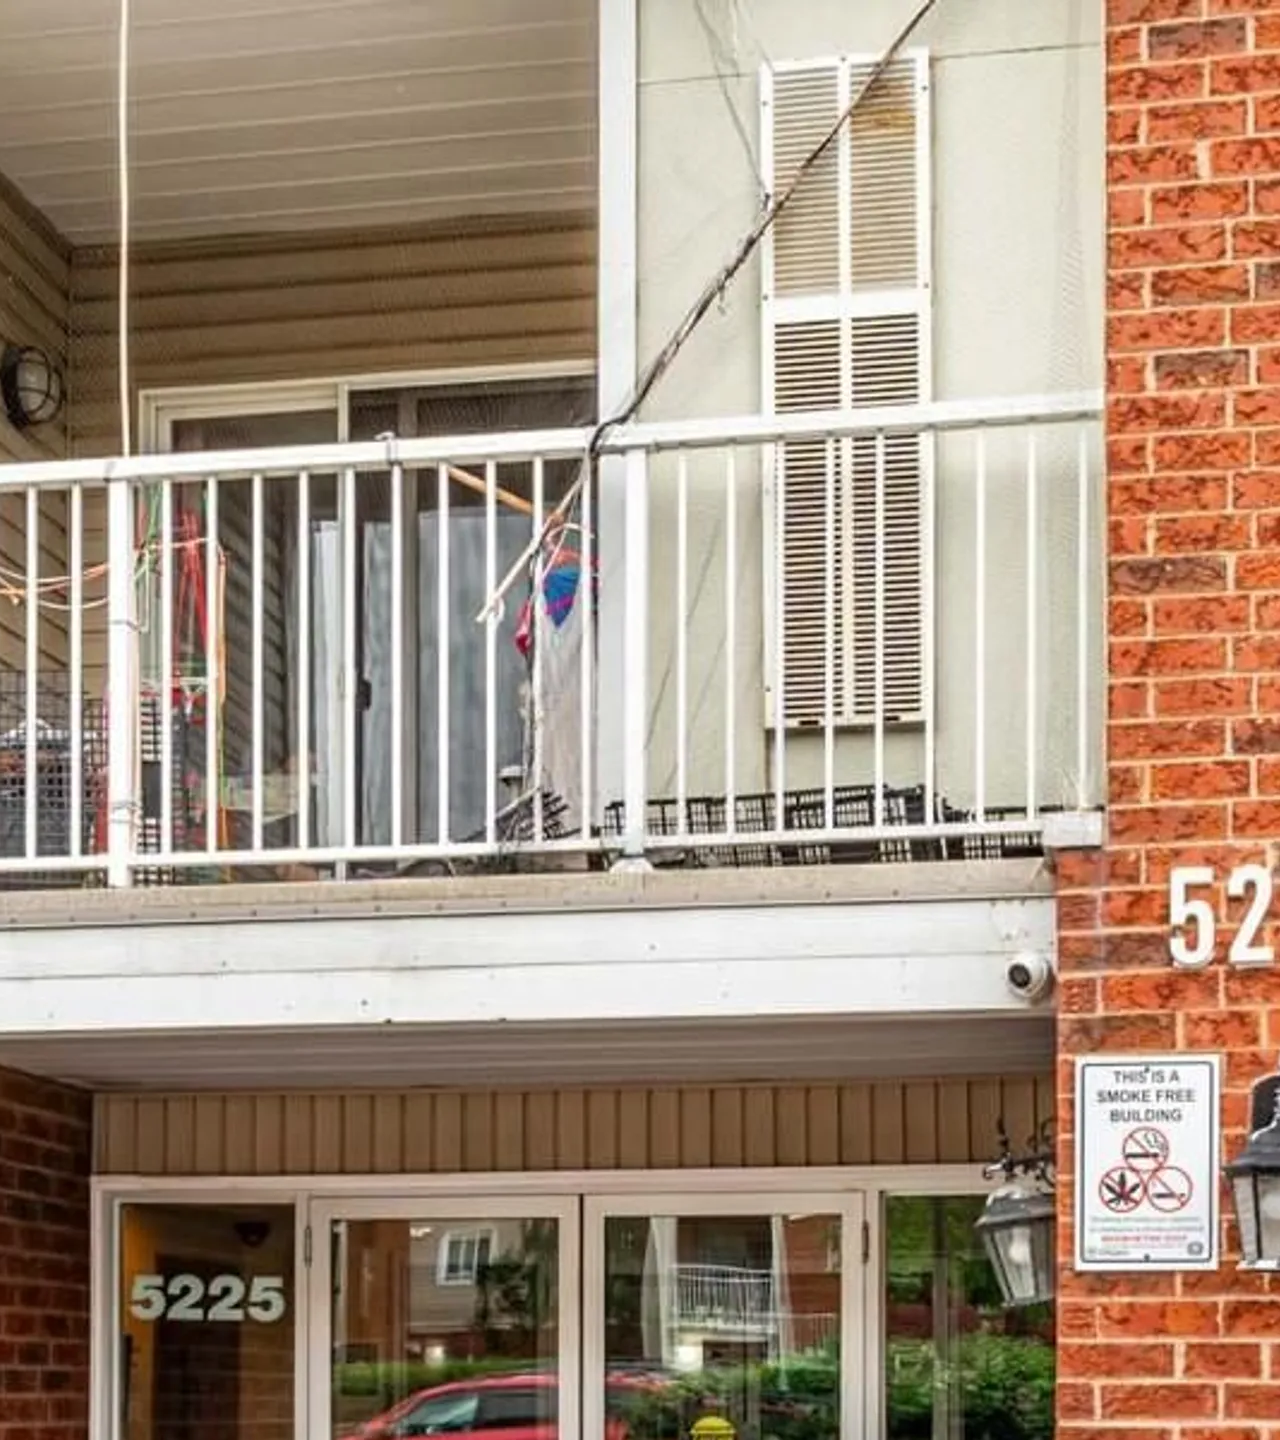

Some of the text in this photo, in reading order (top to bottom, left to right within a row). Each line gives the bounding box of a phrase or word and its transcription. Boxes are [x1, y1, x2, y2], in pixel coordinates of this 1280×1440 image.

[1113, 1070, 1180, 1084] THIS IS A
[1096, 1089, 1196, 1103] SMOKE FREE
[1110, 1108, 1183, 1122] BUILDING
[131, 1273, 286, 1322] 5225
